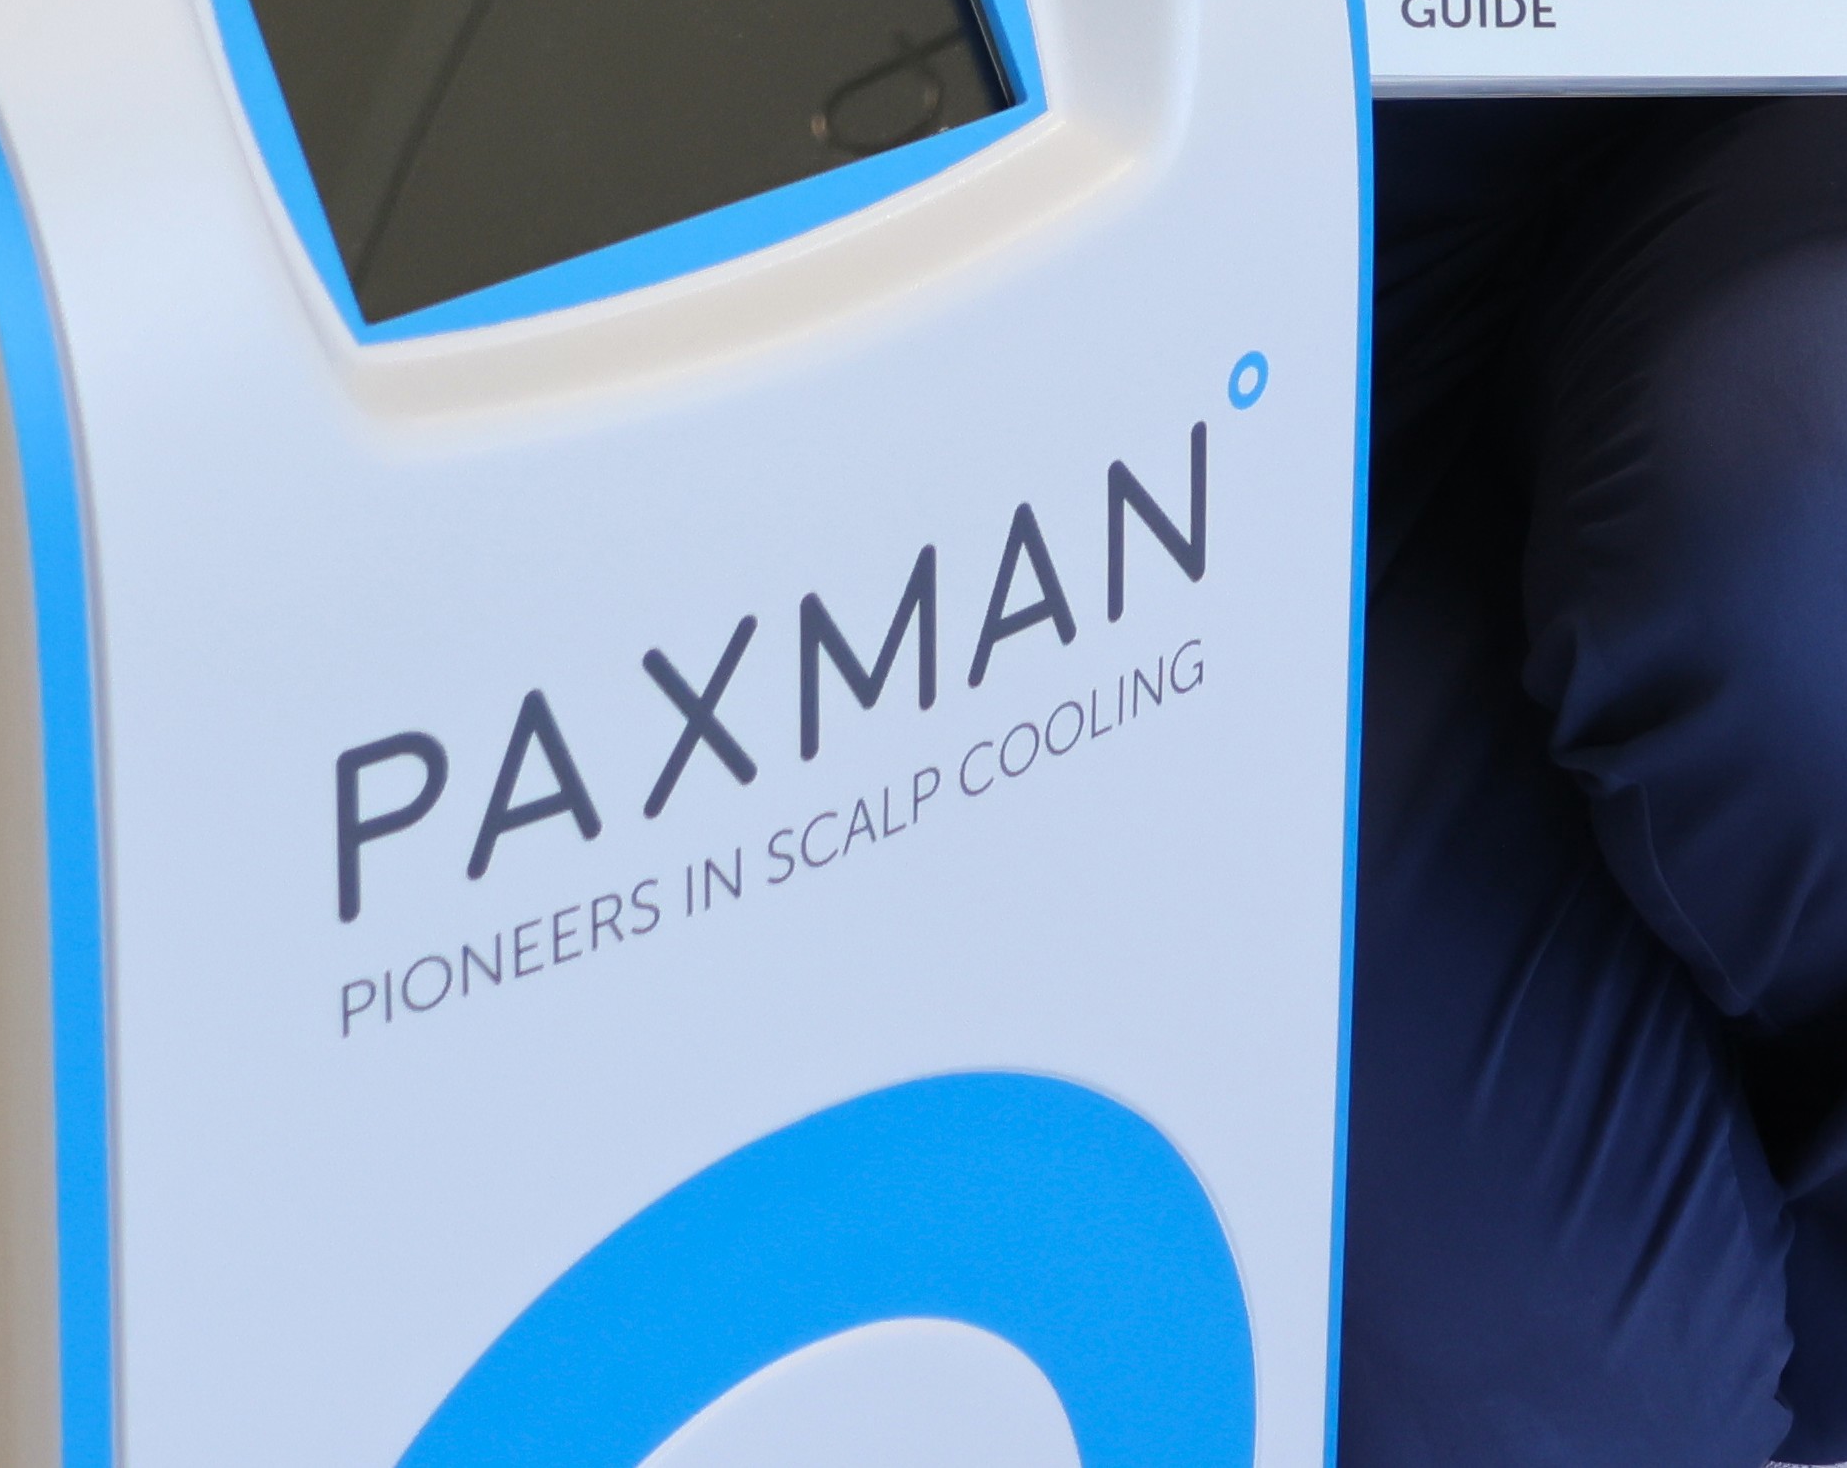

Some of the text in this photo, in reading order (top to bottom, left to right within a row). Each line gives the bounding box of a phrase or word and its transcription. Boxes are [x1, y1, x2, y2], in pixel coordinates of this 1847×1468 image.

[341, 639, 1204, 1038] PIONEERS IN SCALP COOLING
